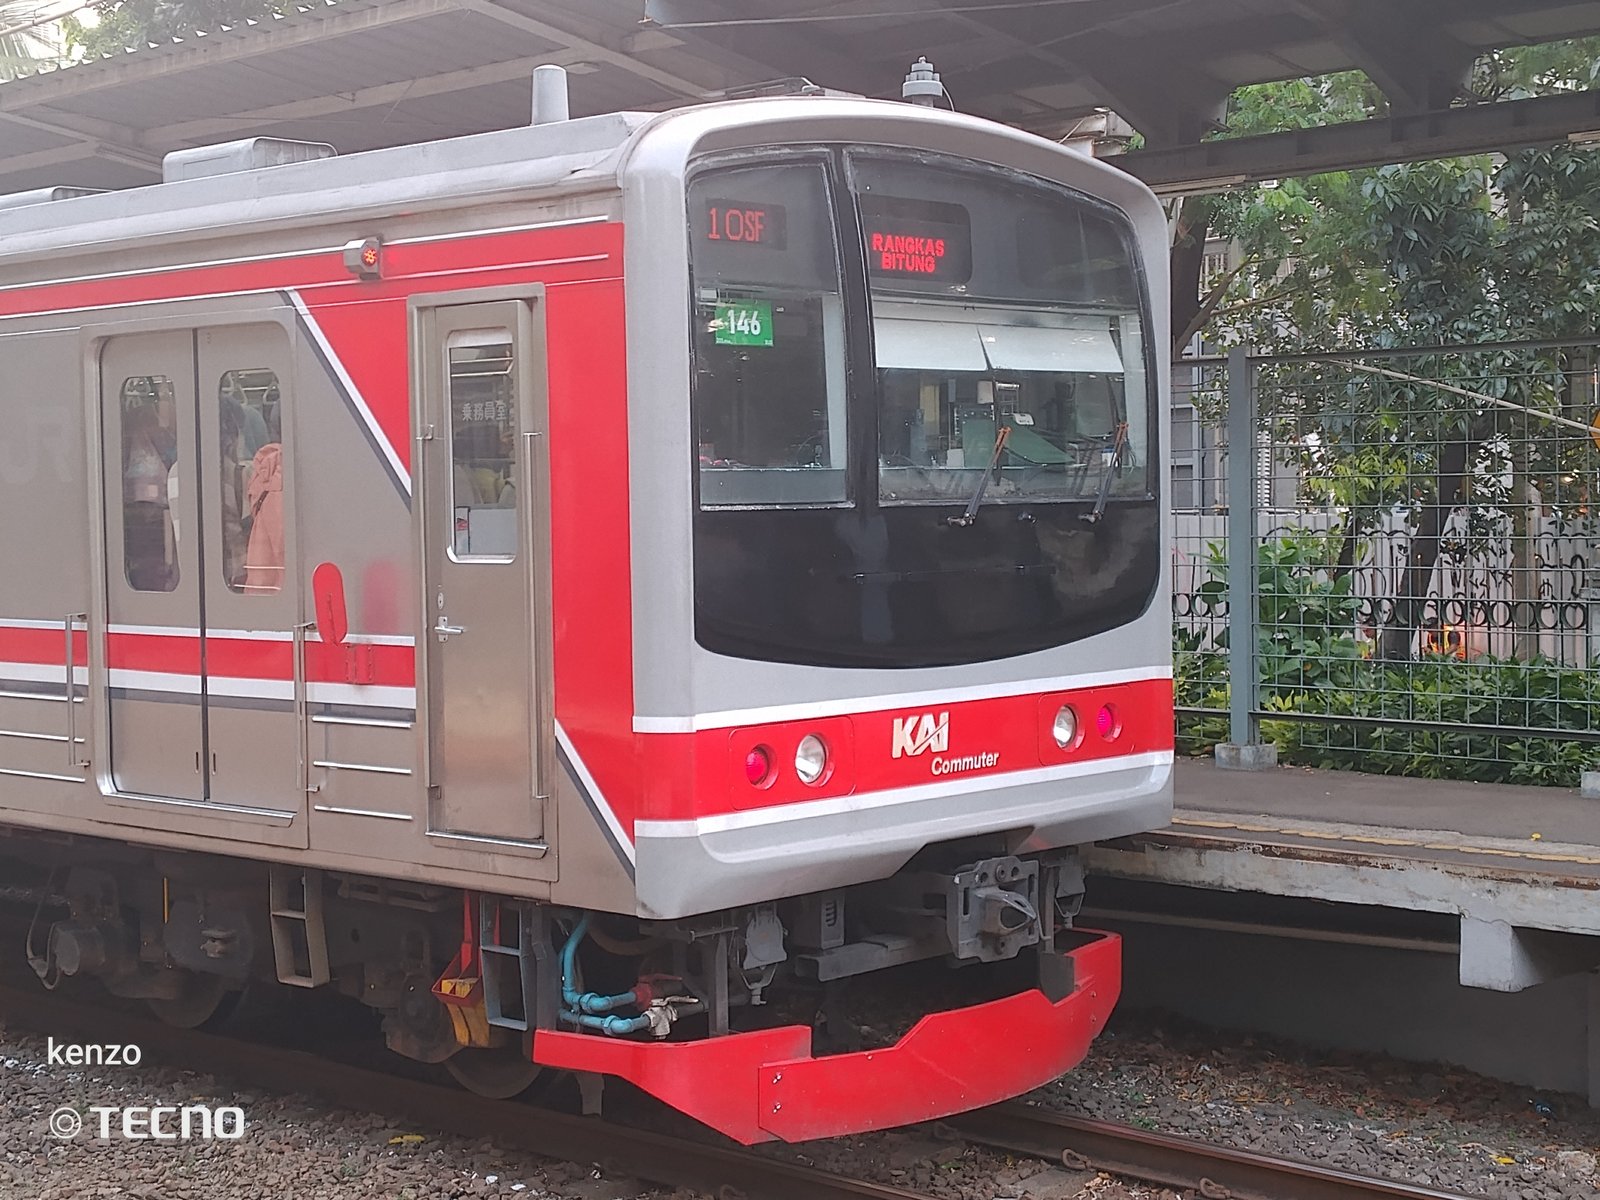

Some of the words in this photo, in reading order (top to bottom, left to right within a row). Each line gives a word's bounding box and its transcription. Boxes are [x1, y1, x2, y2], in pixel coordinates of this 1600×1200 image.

[872, 232, 945, 257] RANGKAS
[881, 254, 936, 273] BITUNG
[727, 309, 761, 335] 146
[892, 711, 950, 759] KAI
[931, 752, 1000, 776] Commuter
